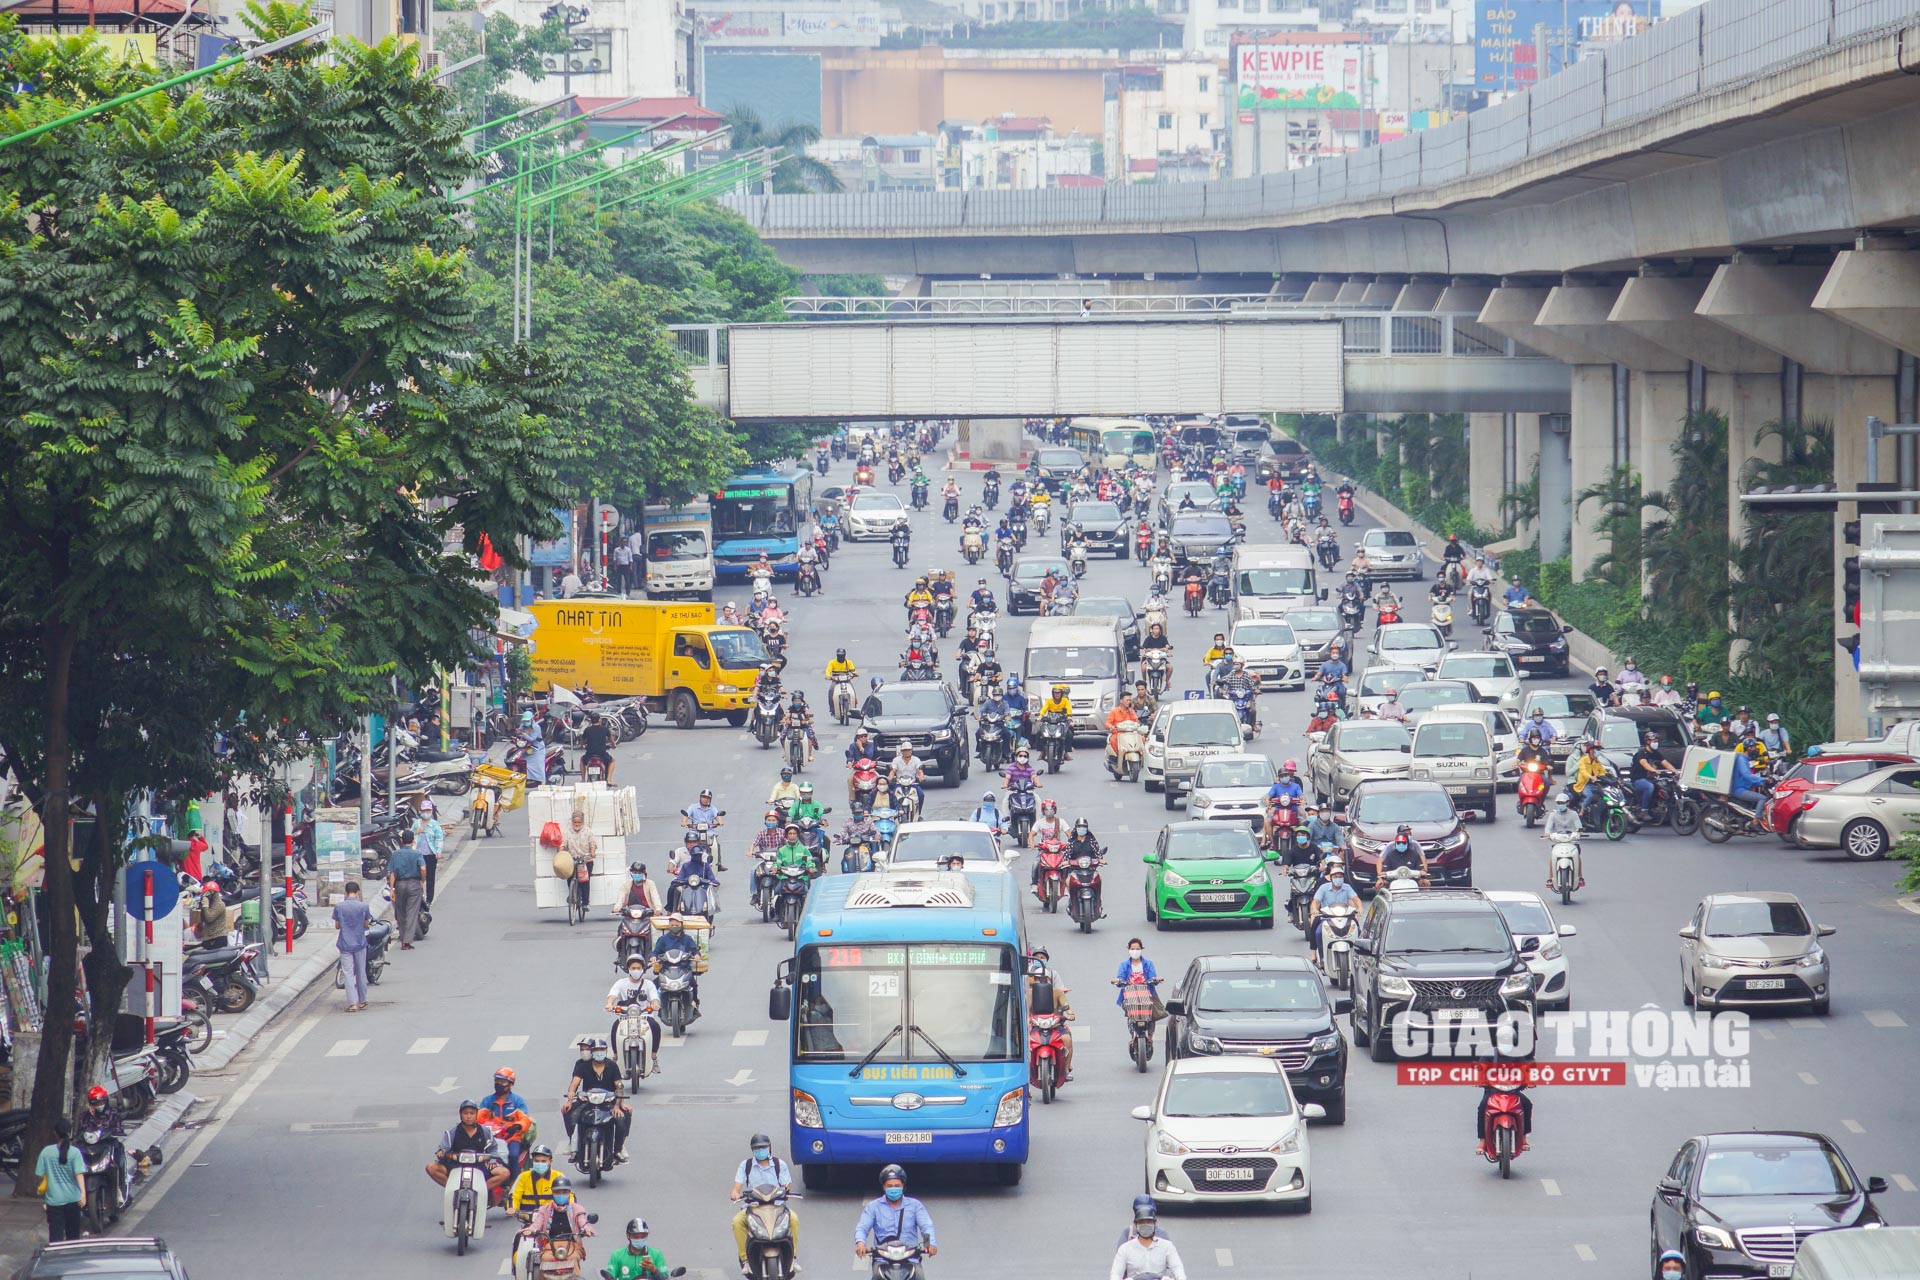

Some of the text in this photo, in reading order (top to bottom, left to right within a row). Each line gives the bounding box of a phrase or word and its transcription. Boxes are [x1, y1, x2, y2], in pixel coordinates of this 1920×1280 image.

[1243, 51, 1324, 71] KEWPIE
[829, 947, 862, 966] 21B
[888, 952, 900, 964] BX
[863, 1067, 887, 1080] BUS
[921, 1067, 953, 1080] NINH
[887, 1133, 931, 1143] 29B-621.80
[1207, 1170, 1252, 1179] 30F-051.14
